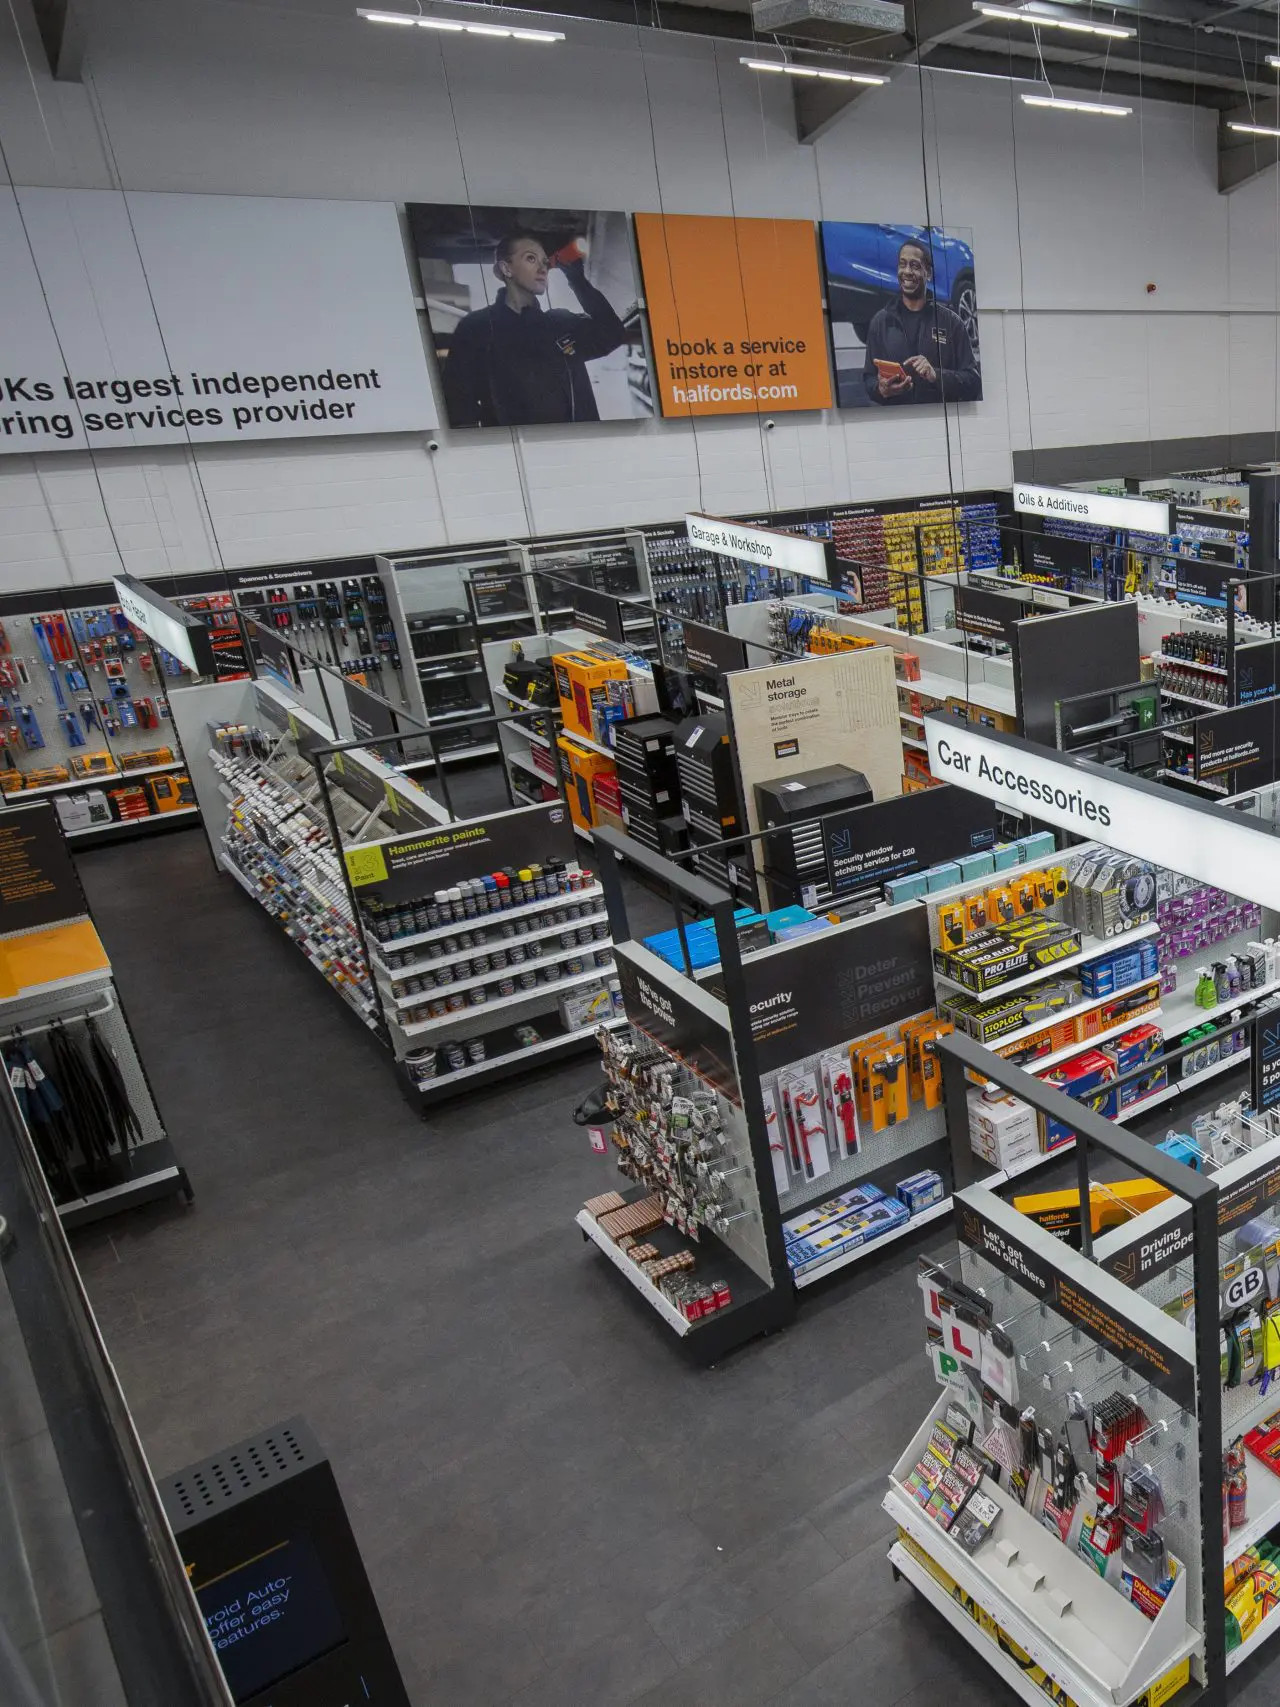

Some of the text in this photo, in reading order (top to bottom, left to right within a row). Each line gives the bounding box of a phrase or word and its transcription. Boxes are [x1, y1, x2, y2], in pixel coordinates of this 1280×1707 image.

[667, 337, 806, 356] book a service
[670, 360, 787, 379] instore or at
[0, 368, 381, 405] Ks largest independent
[673, 383, 797, 403] halfords.com
[0, 398, 356, 439] ring services provider
[1018, 492, 1089, 514] Oils & Additives
[691, 524, 774, 560] Garage & Workshop
[238, 569, 313, 584] Spanners & Screwdrivers
[766, 676, 795, 690] Metal
[767, 688, 807, 701] storage
[1240, 690, 1252, 699] Has
[1253, 687, 1268, 697] your
[1200, 752, 1212, 761] Find
[1212, 749, 1226, 758] more
[1234, 740, 1254, 752] security
[1200, 758, 1222, 770] products
[1228, 747, 1260, 760] halfords.com
[936, 738, 1112, 828] Car Accessories
[388, 826, 486, 857] Hammerite paints
[833, 844, 894, 869] Security window
[834, 862, 863, 878] etching
[863, 854, 889, 869] service
[890, 852, 902, 861] for
[902, 847, 916, 858] £20
[354, 872, 375, 882] Paint
[957, 937, 1004, 956] PRO ELITE
[971, 944, 1018, 965] PRO ELITE
[854, 955, 898, 980] Deter
[984, 952, 1029, 977] PRO ELITE
[637, 976, 673, 1013] We've got
[857, 967, 917, 999] Prevent
[640, 992, 677, 1028] the power
[749, 990, 793, 1014] ecurity
[859, 986, 922, 1019] Recover
[975, 996, 1028, 1020] STOPLOCK
[984, 1011, 1023, 1035] STOPLOCK
[1262, 1064, 1271, 1074] Is
[1262, 1076, 1269, 1086] 5
[1039, 1212, 1070, 1223] halfords
[982, 1224, 1023, 1263] Let's get
[1140, 1226, 1181, 1258] Driving
[1140, 1232, 1194, 1272] in Europe
[984, 1238, 1046, 1289] you out there
[1059, 1280, 1077, 1297] Boost
[1228, 1273, 1261, 1304] GB
[930, 1289, 942, 1320] L
[952, 1326, 973, 1359] L
[939, 1351, 959, 1376] P
[246, 1576, 293, 1605] Auto-
[1133, 1579, 1151, 1597] DVSA
[208, 1588, 290, 1639] offer easy
